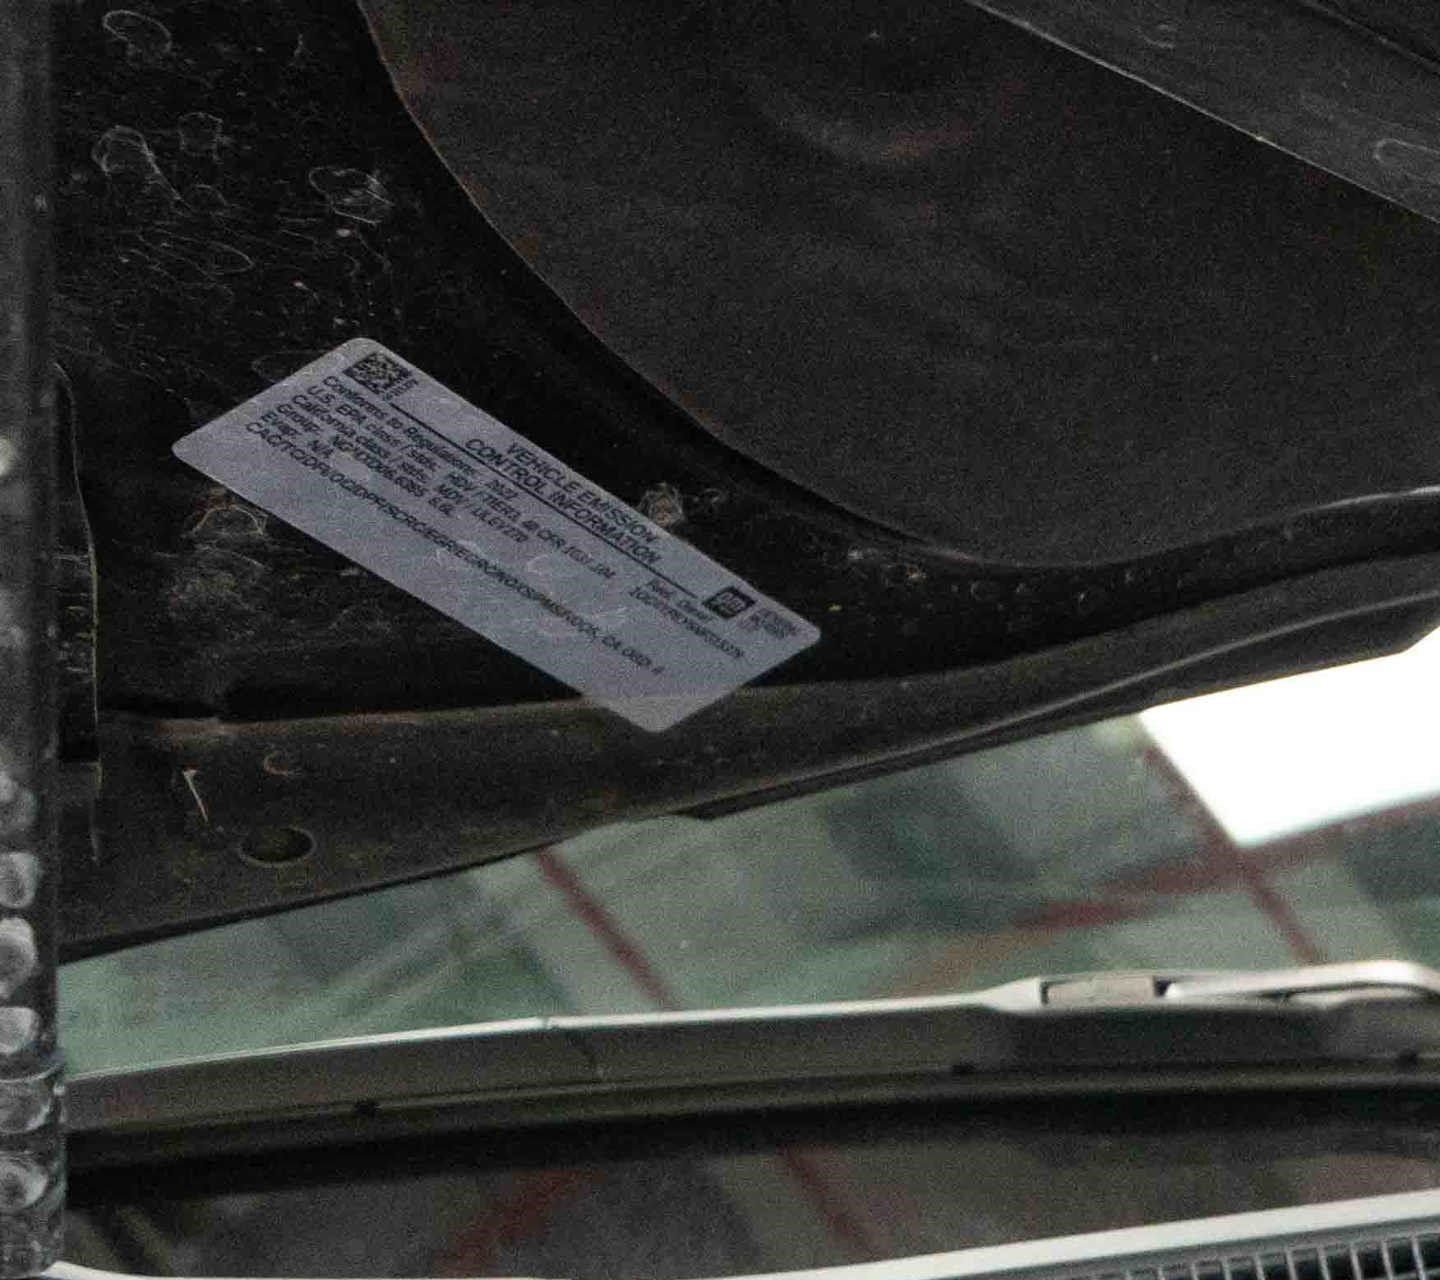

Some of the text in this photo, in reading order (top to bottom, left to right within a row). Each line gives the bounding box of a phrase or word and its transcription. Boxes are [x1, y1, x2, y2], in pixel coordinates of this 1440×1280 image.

[287, 392, 360, 438] California
[303, 384, 338, 406] U.S.
[332, 402, 370, 426] EPA
[318, 374, 392, 420] Conforms
[384, 416, 407, 430] to
[461, 436, 664, 565] CONTROL INFORMATION
[501, 442, 662, 544] VEHICLE EMISSION
